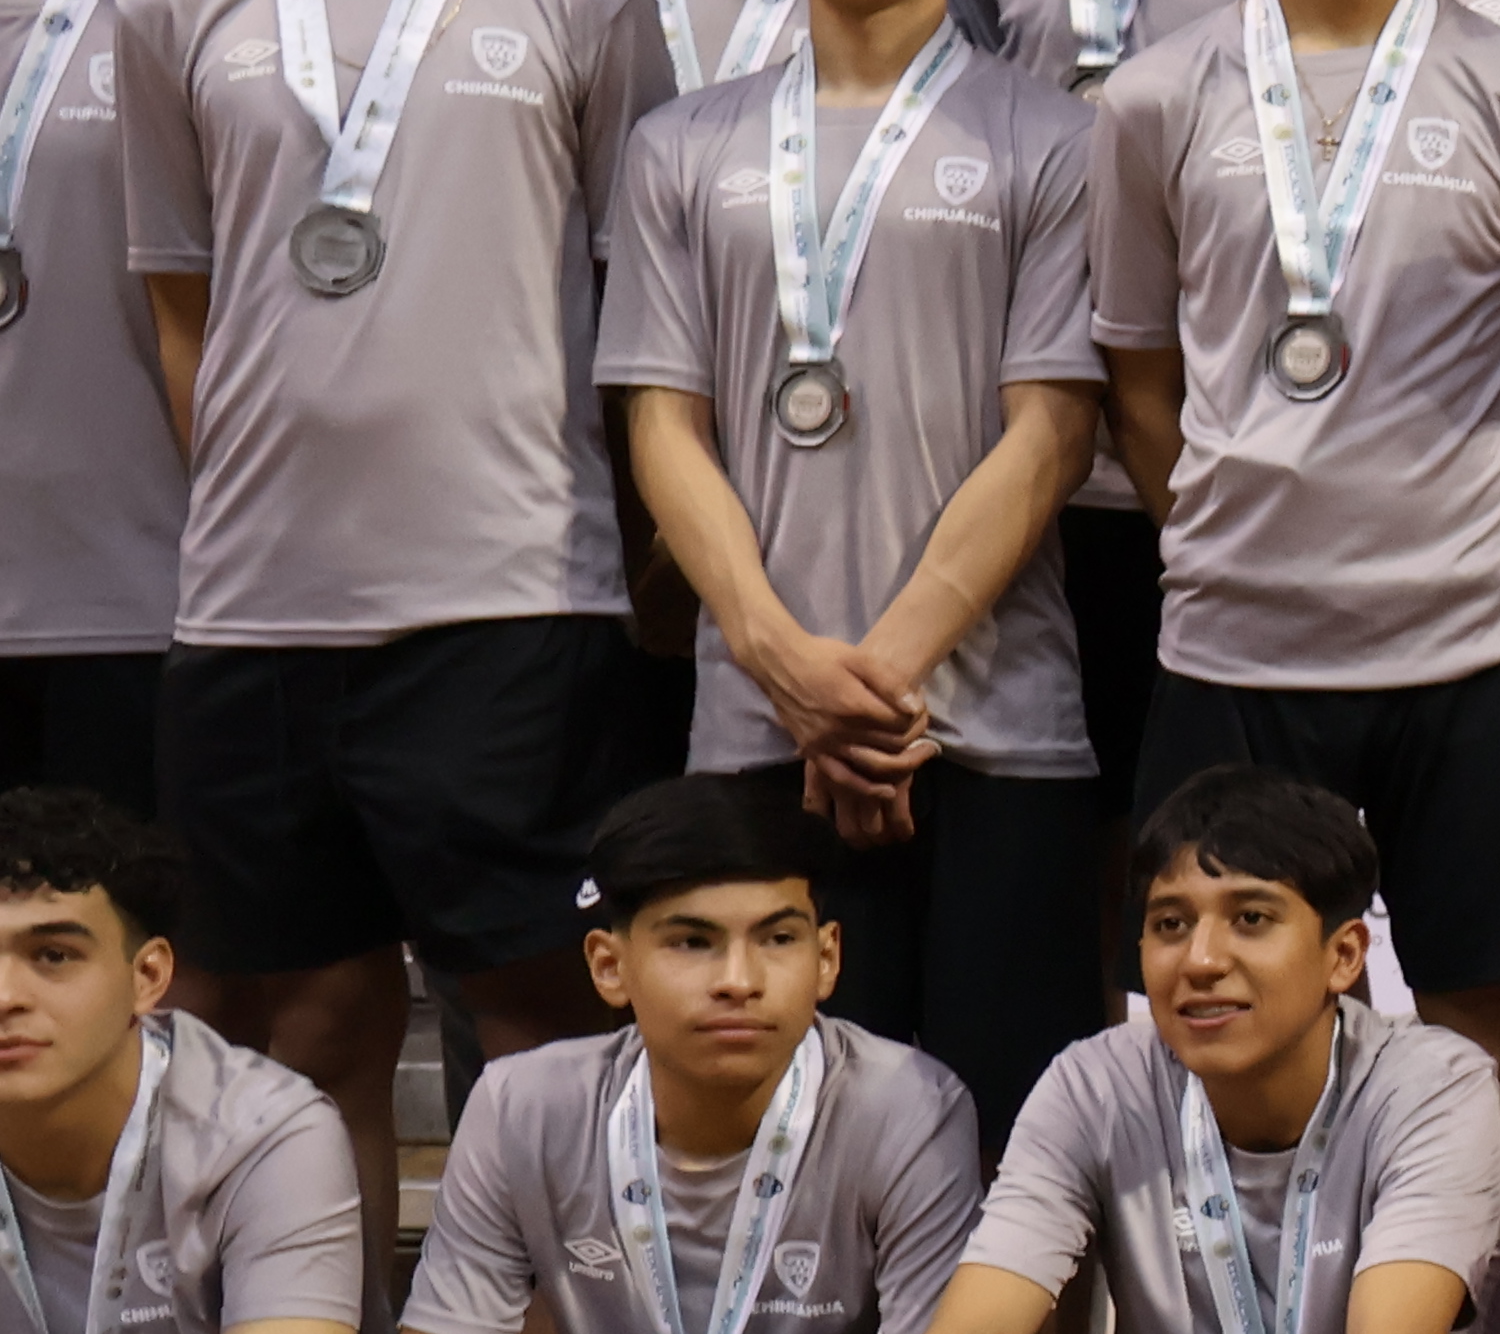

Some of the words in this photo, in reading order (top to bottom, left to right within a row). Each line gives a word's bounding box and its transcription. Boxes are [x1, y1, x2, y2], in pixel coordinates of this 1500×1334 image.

[444, 79, 545, 106] CHIHUAHUA
[1382, 170, 1478, 194] CHIHUAHUA
[903, 207, 1000, 231] CHIHUAHUA
